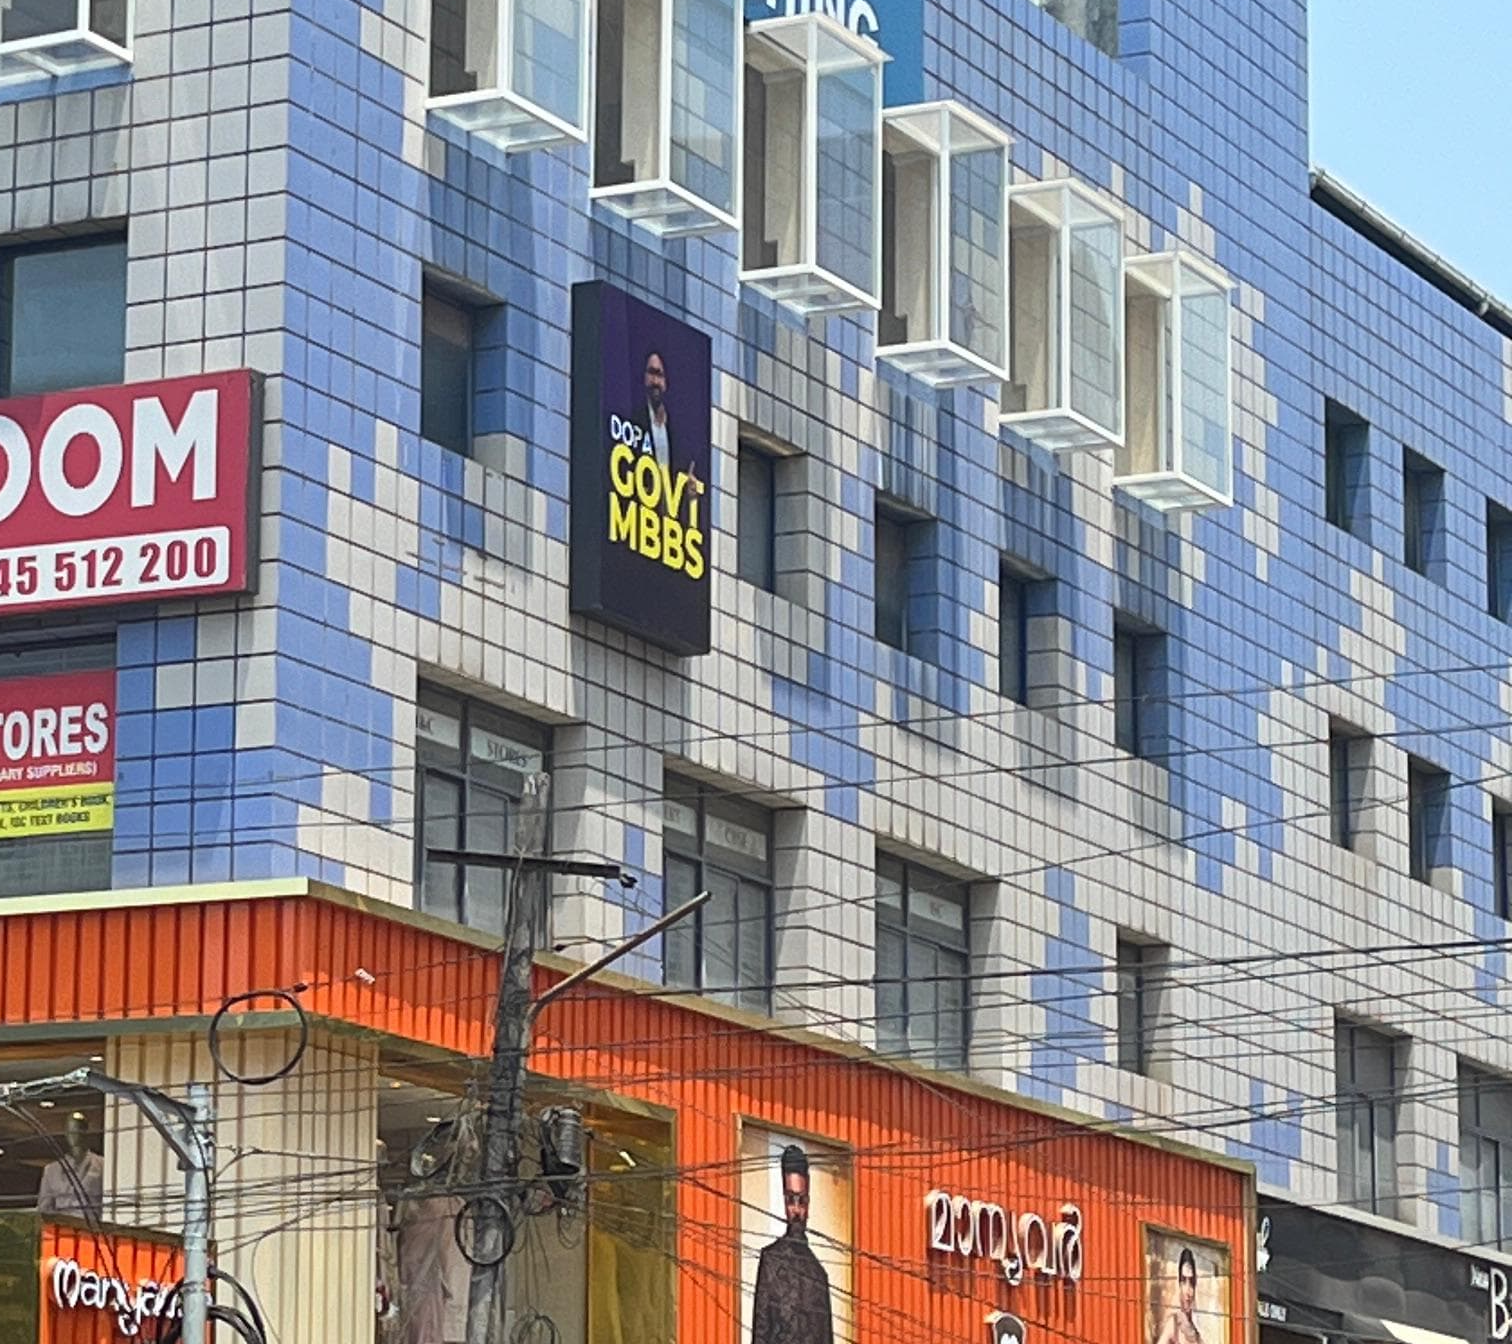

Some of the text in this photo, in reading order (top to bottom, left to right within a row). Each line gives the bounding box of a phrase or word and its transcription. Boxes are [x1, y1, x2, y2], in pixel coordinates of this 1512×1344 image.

[611, 415, 653, 455] DOPA
[609, 491, 705, 579] MBBS
[55, 547, 122, 590] 512
[141, 537, 216, 583] 200
